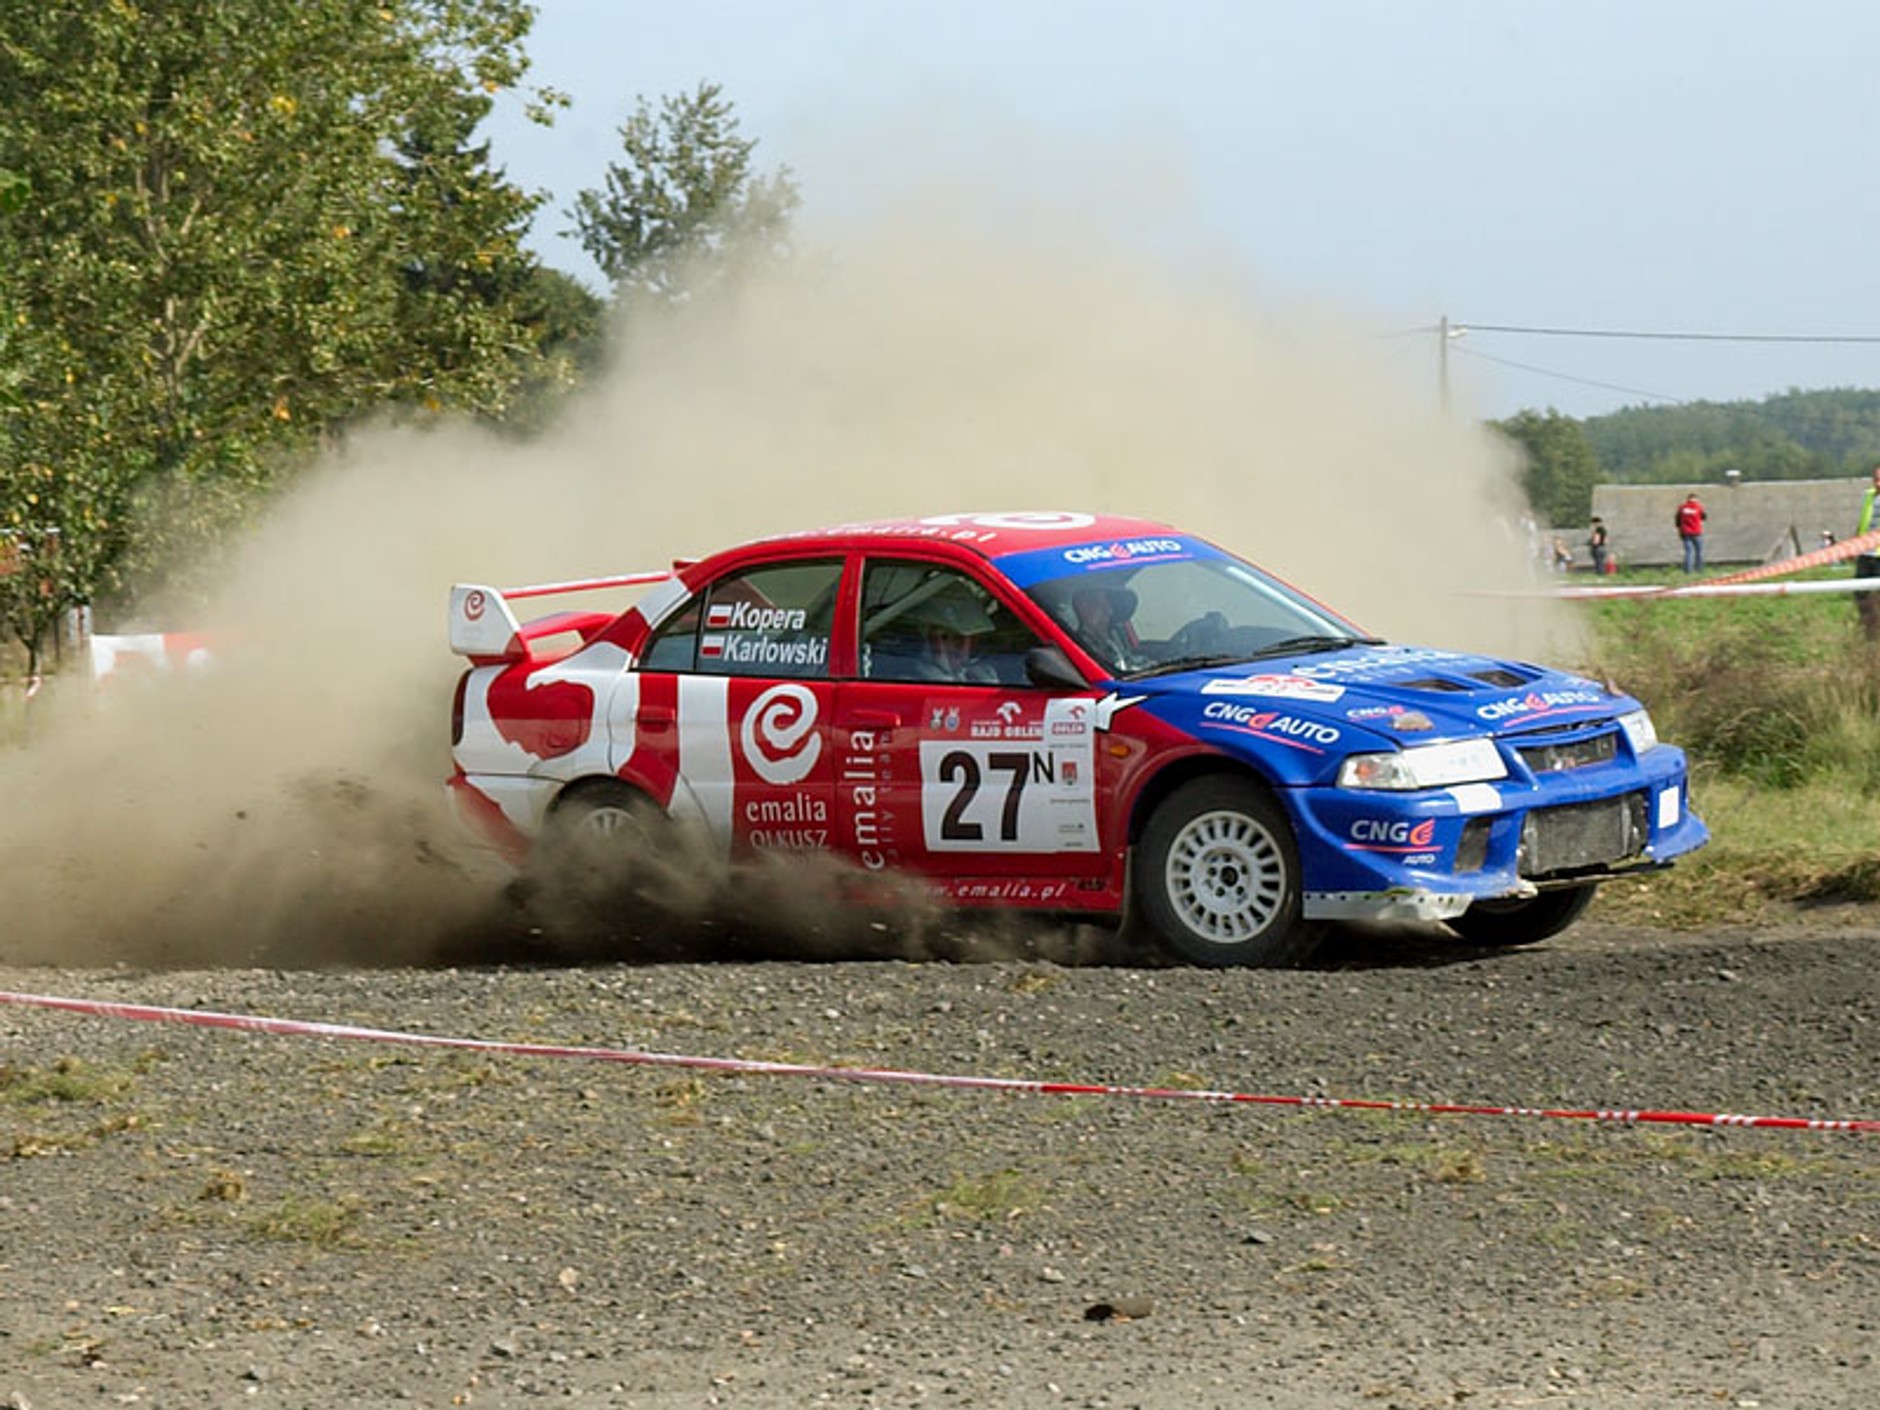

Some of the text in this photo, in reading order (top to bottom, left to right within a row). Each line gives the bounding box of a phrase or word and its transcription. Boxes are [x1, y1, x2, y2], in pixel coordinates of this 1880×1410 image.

[731, 601, 806, 635] Kopera
[1203, 702, 1340, 744] CNG AUTO
[1477, 698, 1529, 720] CNG
[746, 791, 828, 822] emalia
[843, 730, 885, 870] emalia
[939, 750, 1054, 842] 27 N
[1350, 820, 1410, 842] CNG
